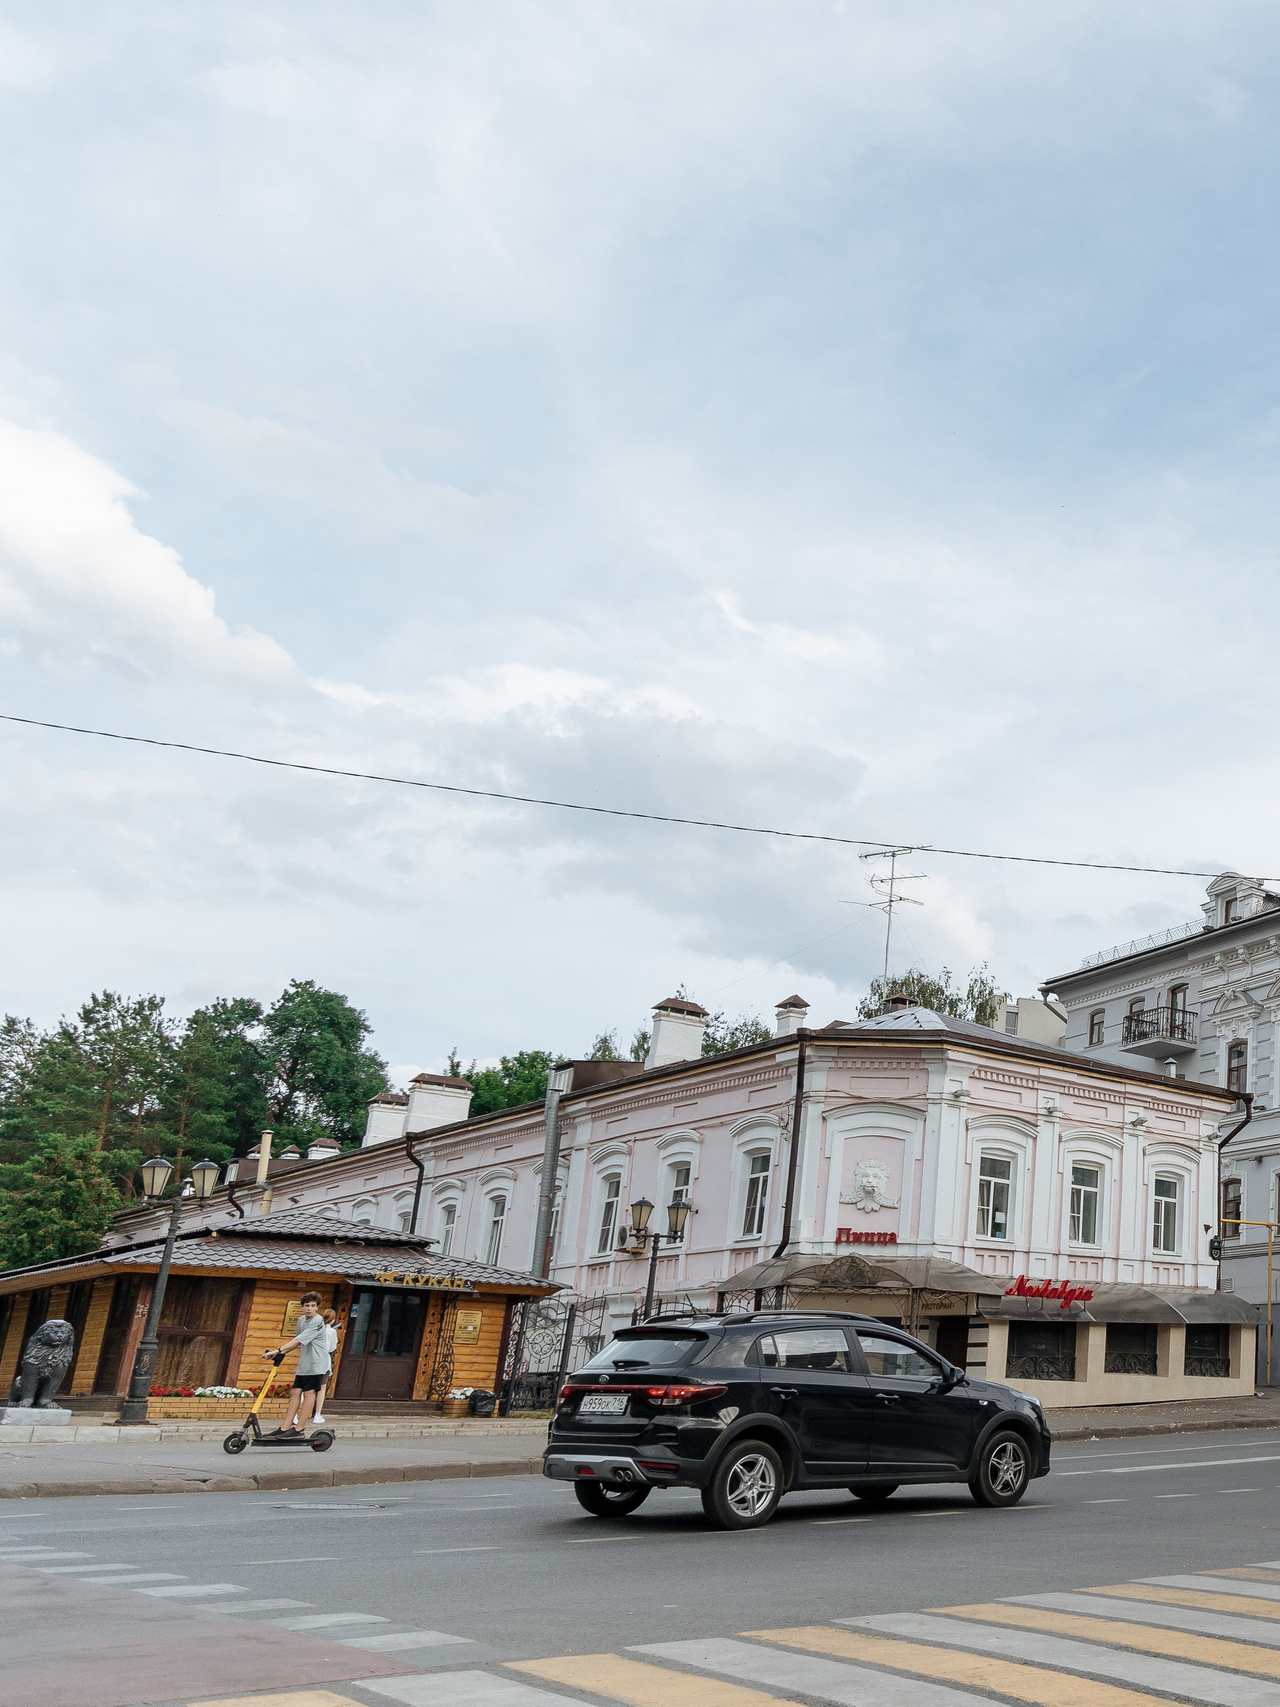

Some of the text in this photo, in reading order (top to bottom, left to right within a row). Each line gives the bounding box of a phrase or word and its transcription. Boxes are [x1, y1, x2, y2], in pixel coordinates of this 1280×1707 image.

[836, 1227, 897, 1246] Пицца
[402, 1273, 465, 1289] КУКАН
[1005, 1274, 1094, 1309] Nostalgia
